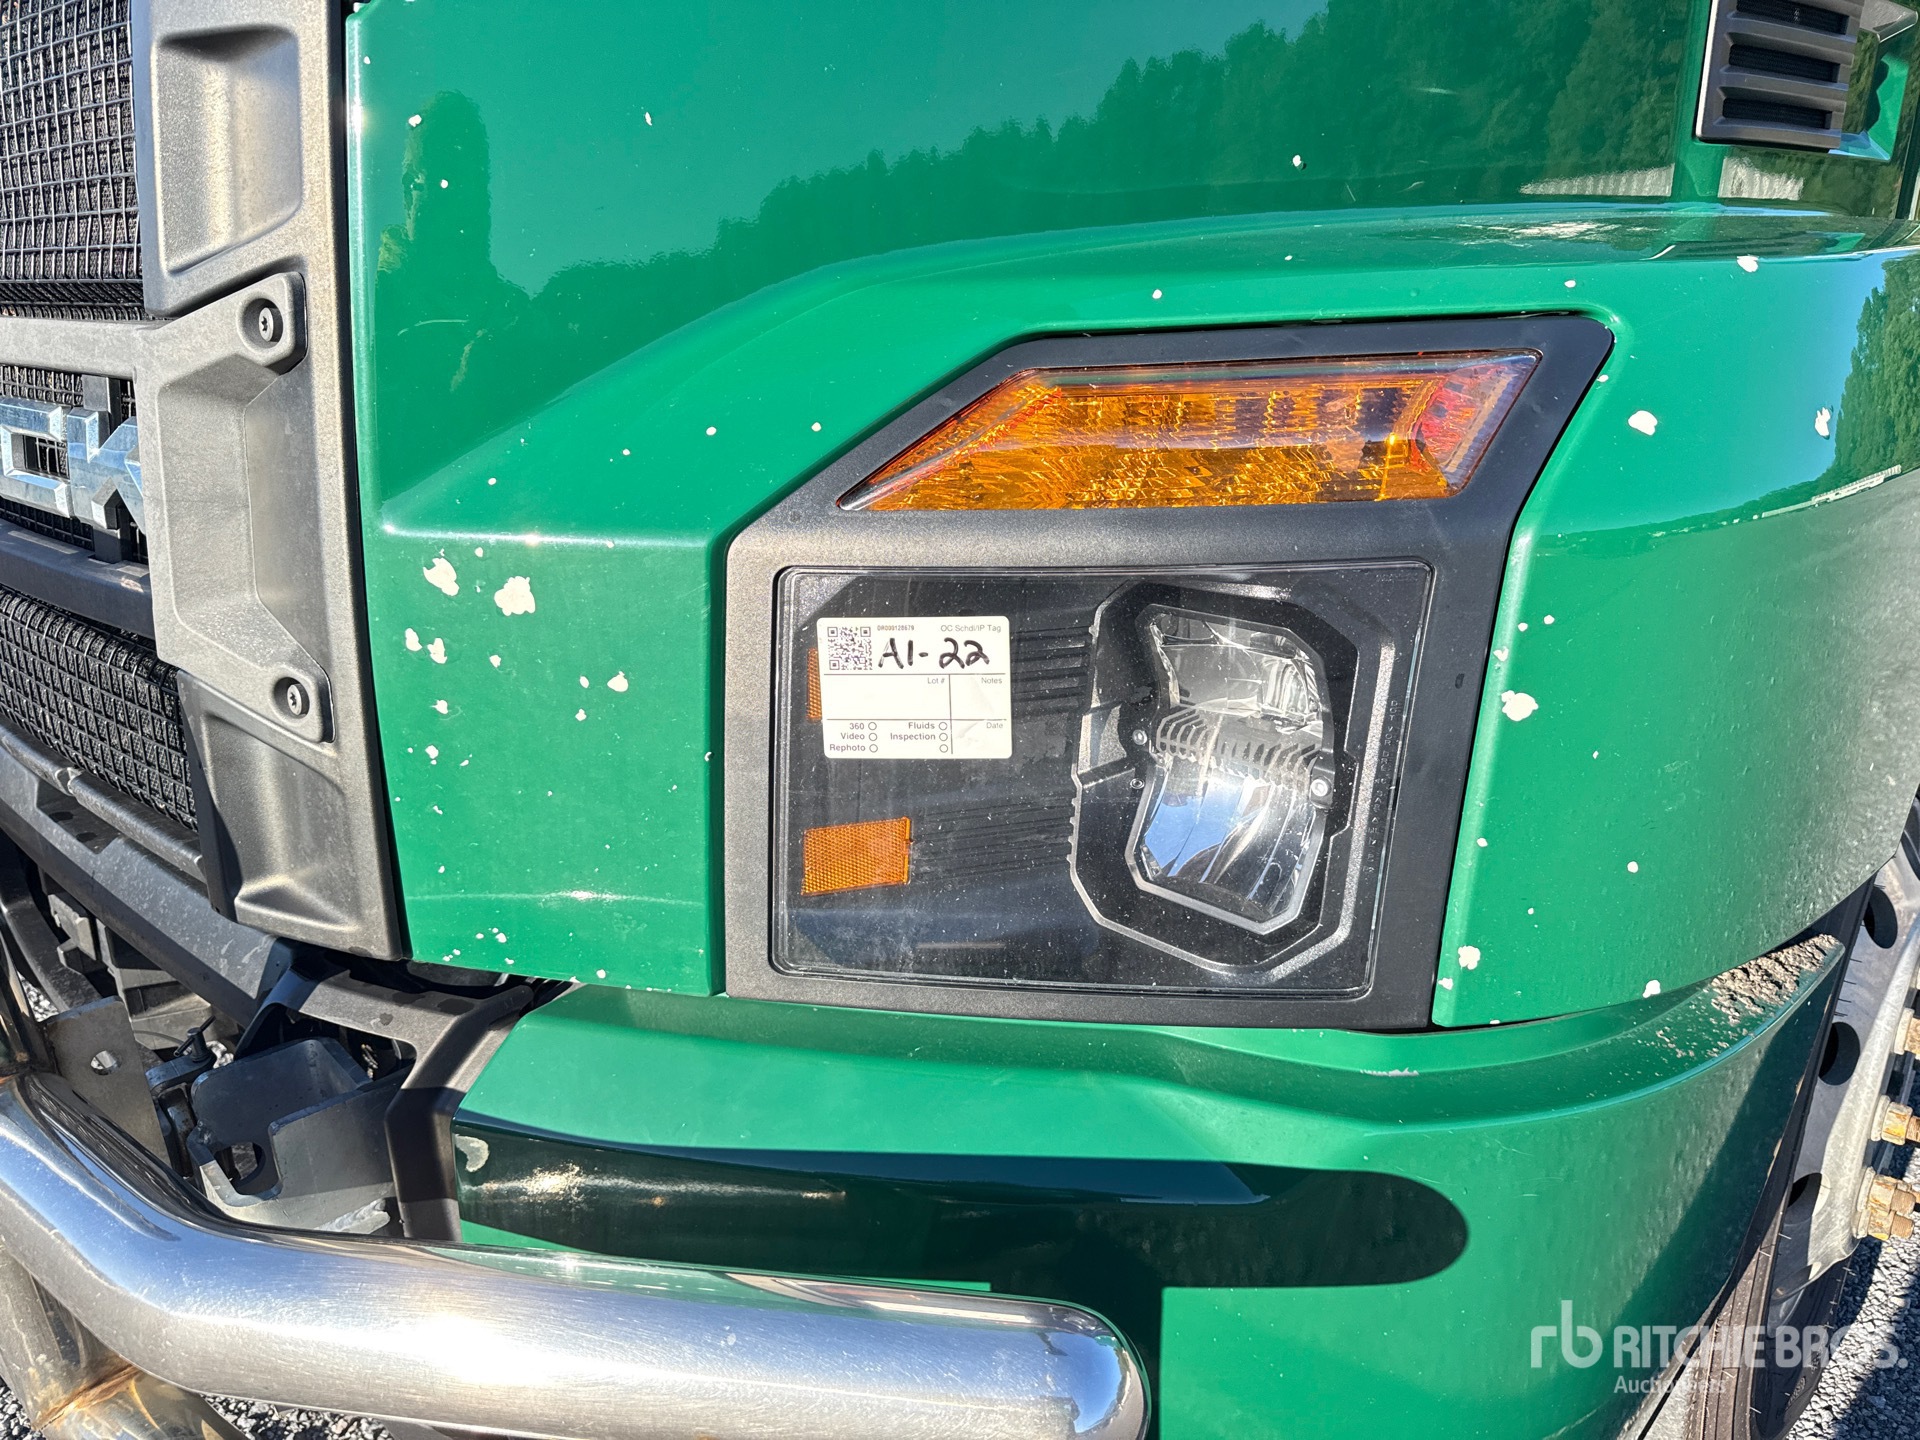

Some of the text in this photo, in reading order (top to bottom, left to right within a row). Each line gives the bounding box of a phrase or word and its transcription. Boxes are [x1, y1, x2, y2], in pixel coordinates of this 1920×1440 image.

[940, 624, 953, 633] OC
[987, 624, 1001, 633] Tag
[981, 676, 1003, 684] Notes
[849, 722, 865, 730] 360
[908, 722, 935, 730] Fluids
[840, 732, 865, 740] Video
[890, 732, 936, 742] Inspection
[829, 743, 866, 753] Rephoto
